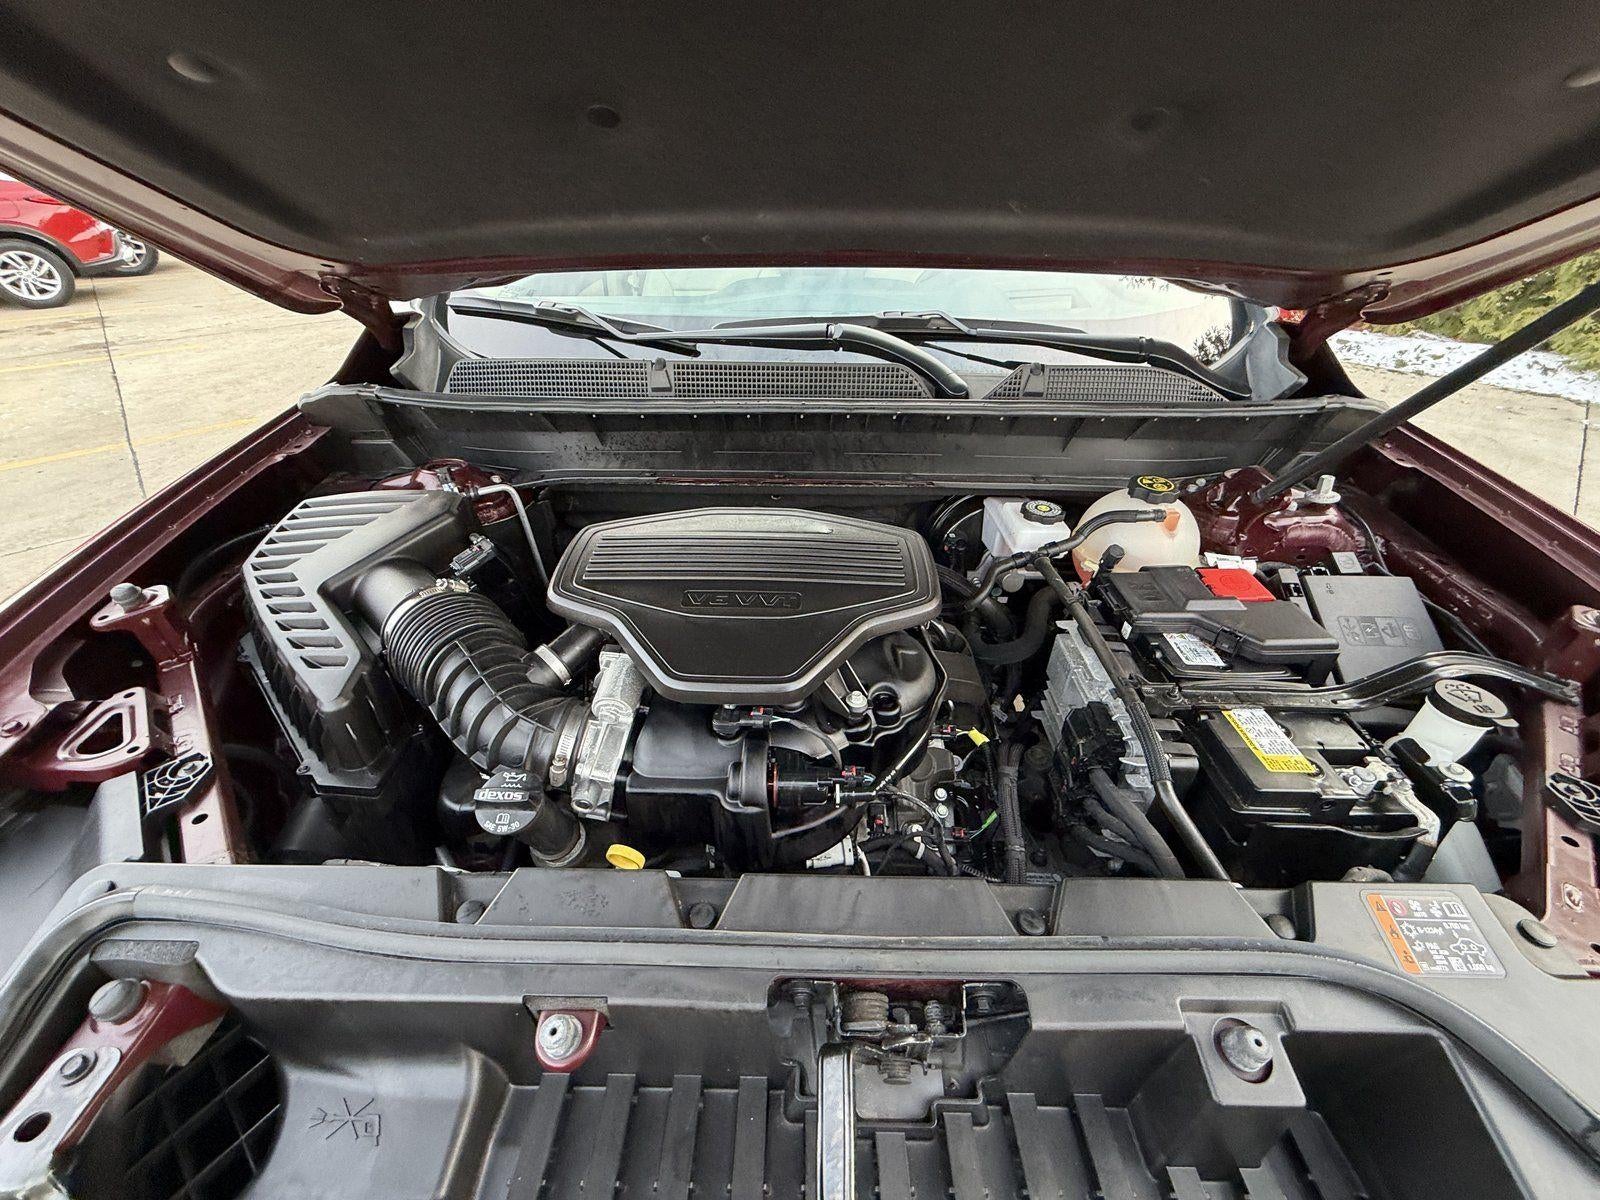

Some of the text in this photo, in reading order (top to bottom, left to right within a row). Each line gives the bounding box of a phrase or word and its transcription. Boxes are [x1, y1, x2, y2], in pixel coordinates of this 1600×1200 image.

[478, 789, 525, 801] dexos
[484, 820, 520, 833] SAE 5W-30
